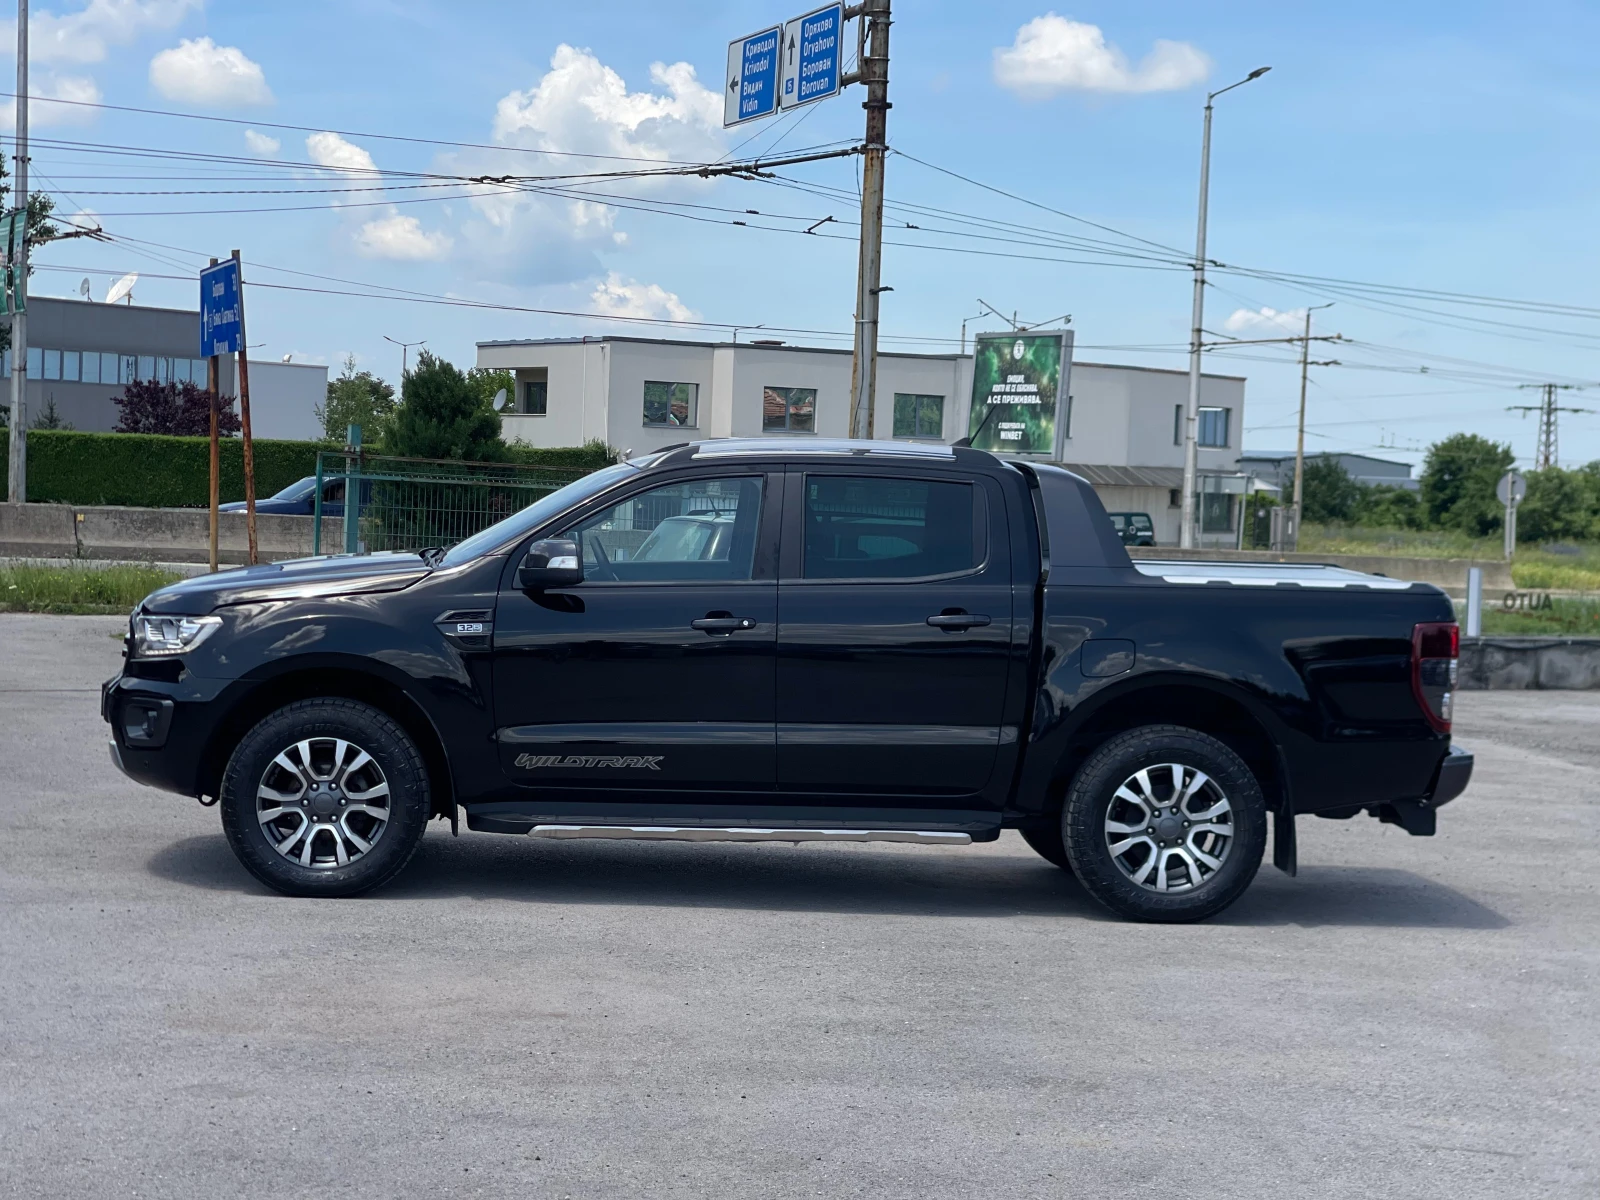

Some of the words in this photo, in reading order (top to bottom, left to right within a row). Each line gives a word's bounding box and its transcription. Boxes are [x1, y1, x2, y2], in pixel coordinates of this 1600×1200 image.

[805, 17, 833, 39] Оряхово
[745, 38, 775, 59] Криводол
[803, 35, 835, 57] Oryahovo
[744, 55, 770, 76] Krivodol
[802, 57, 831, 78] Борован
[743, 80, 763, 96] Видин
[801, 77, 829, 96] Borovan
[742, 99, 758, 113] Vidin
[986, 395, 992, 404] А
[992, 395, 1002, 404] СЕ
[1001, 395, 1042, 404] ПРЕЖИВЯВА.
[1000, 430, 1023, 440] WINBET
[514, 752, 665, 770] WILDTRAK
